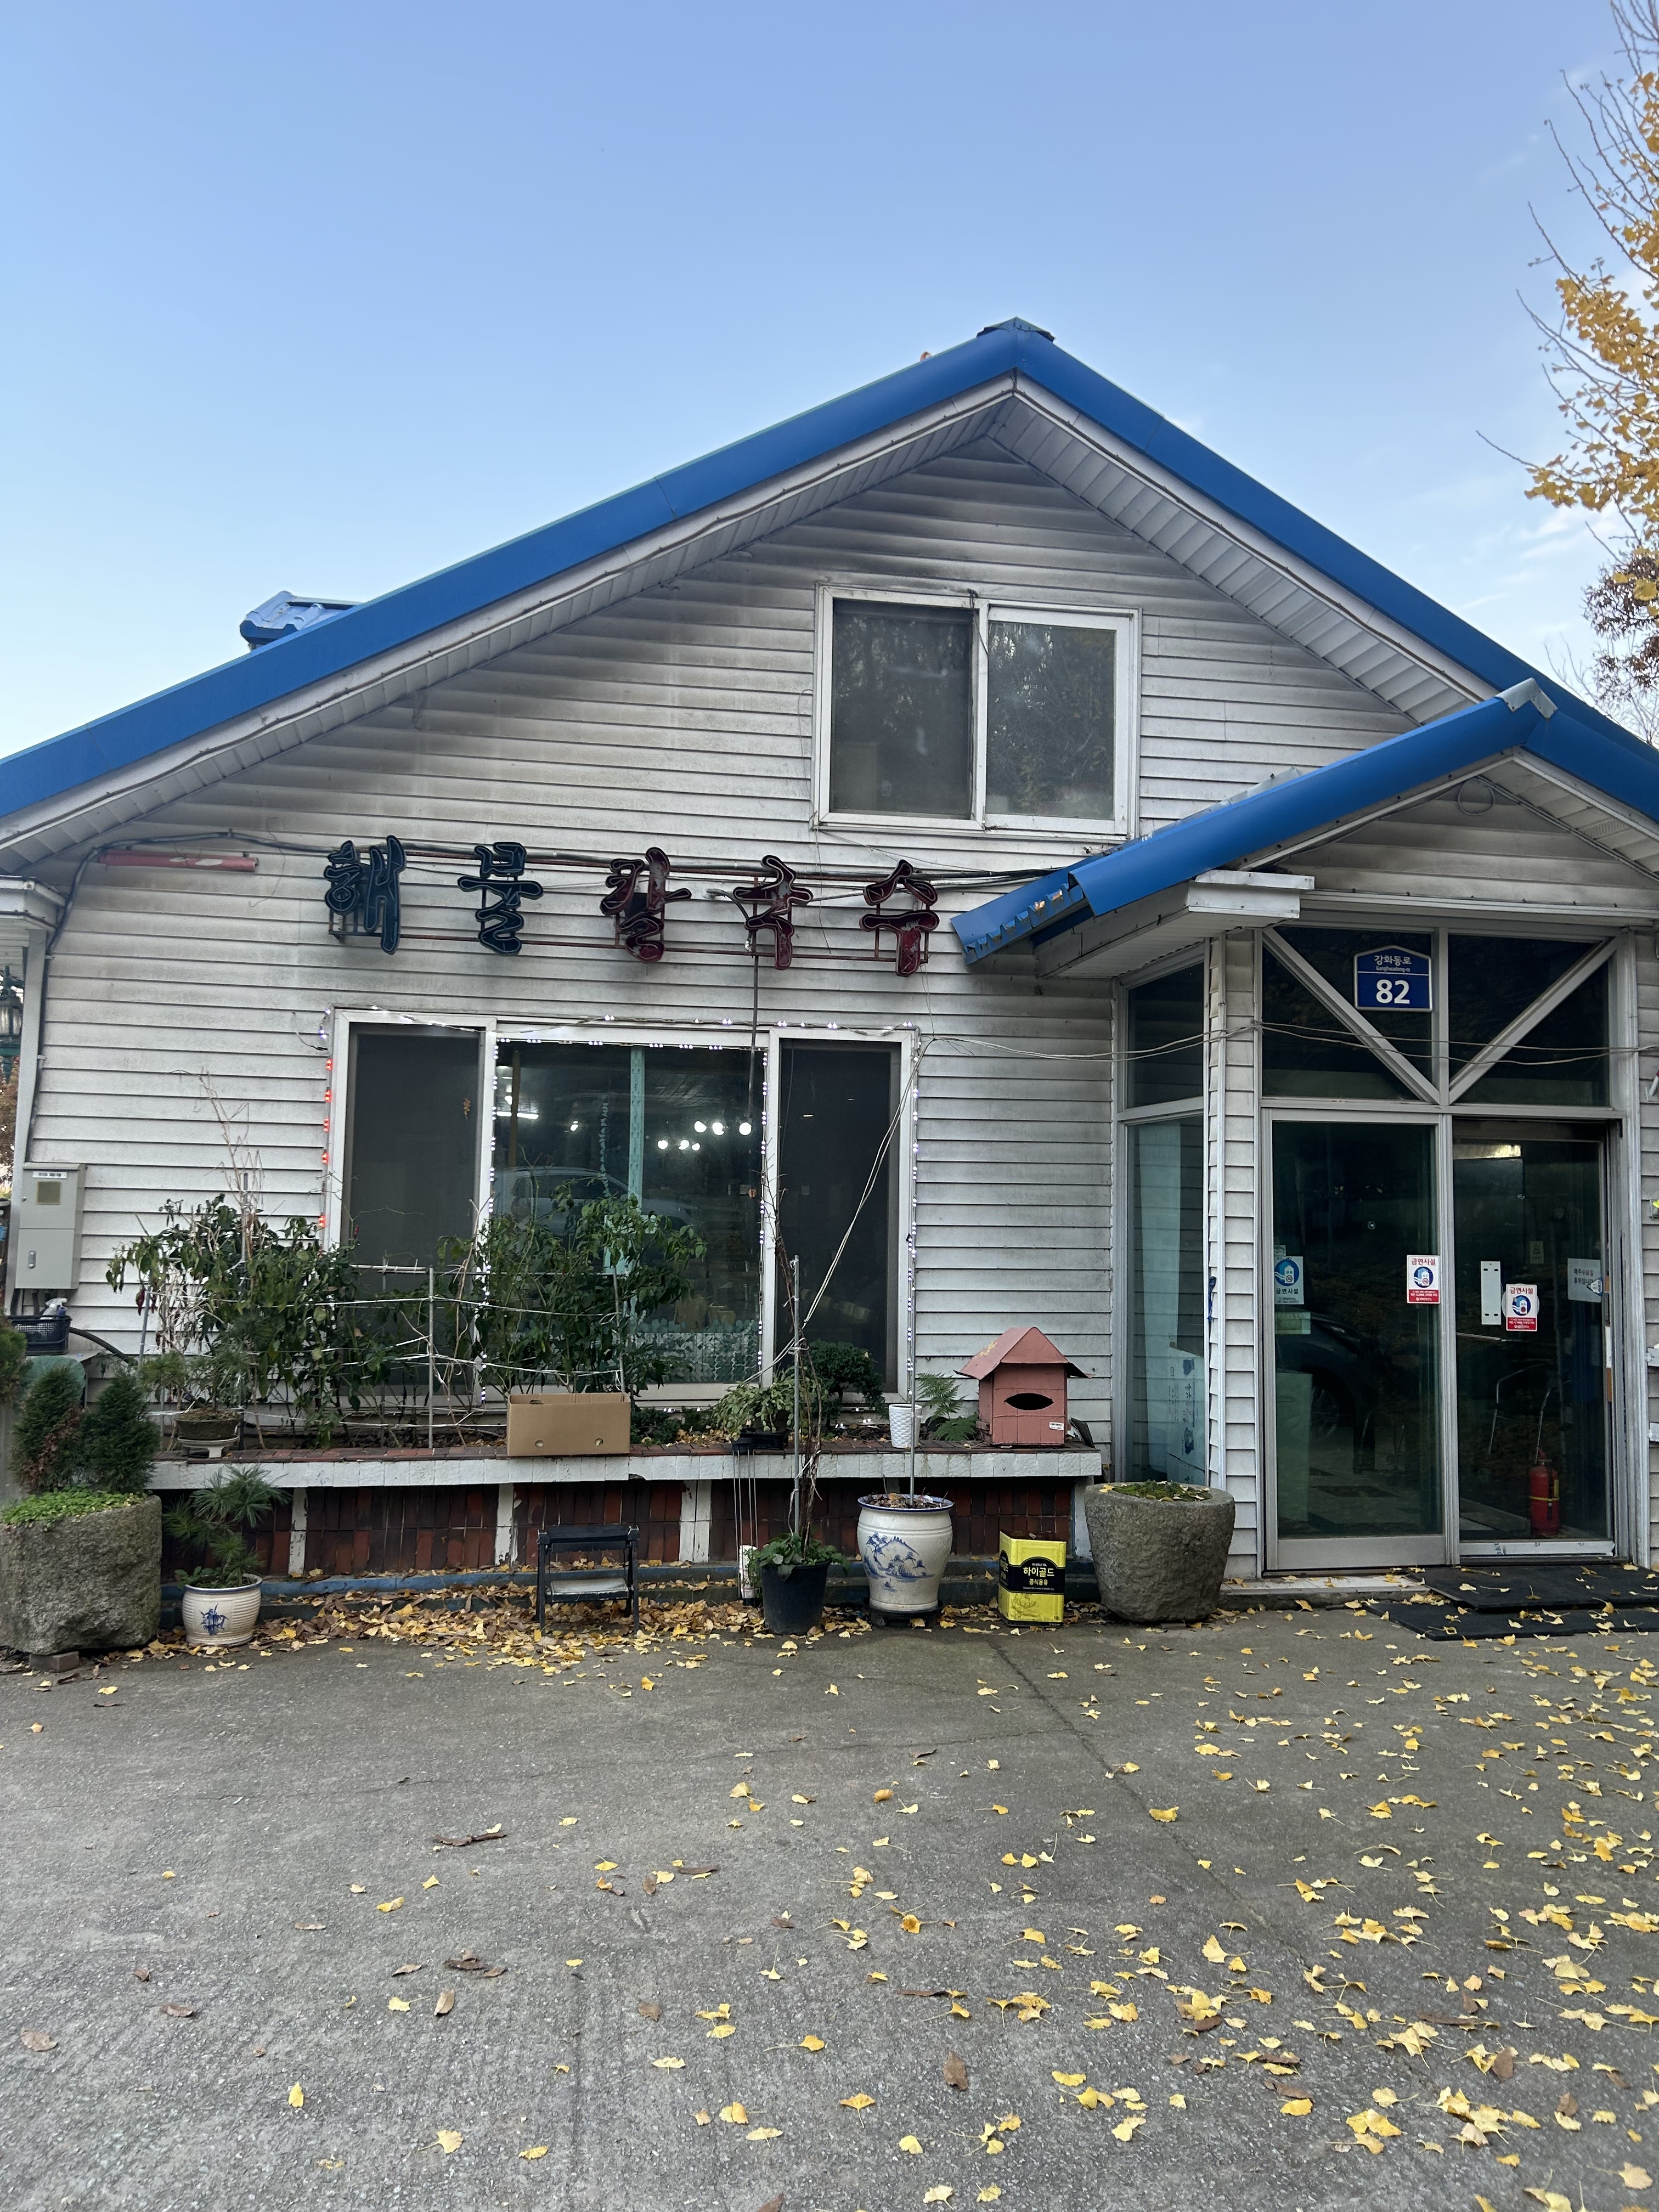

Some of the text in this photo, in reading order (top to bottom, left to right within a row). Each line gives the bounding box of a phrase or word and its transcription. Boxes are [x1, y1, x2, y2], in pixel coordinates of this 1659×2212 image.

[1374, 955, 1412, 966] 강화동로
[1376, 979, 1410, 1004] 82
[1023, 1566, 1055, 1578] 하이골드
